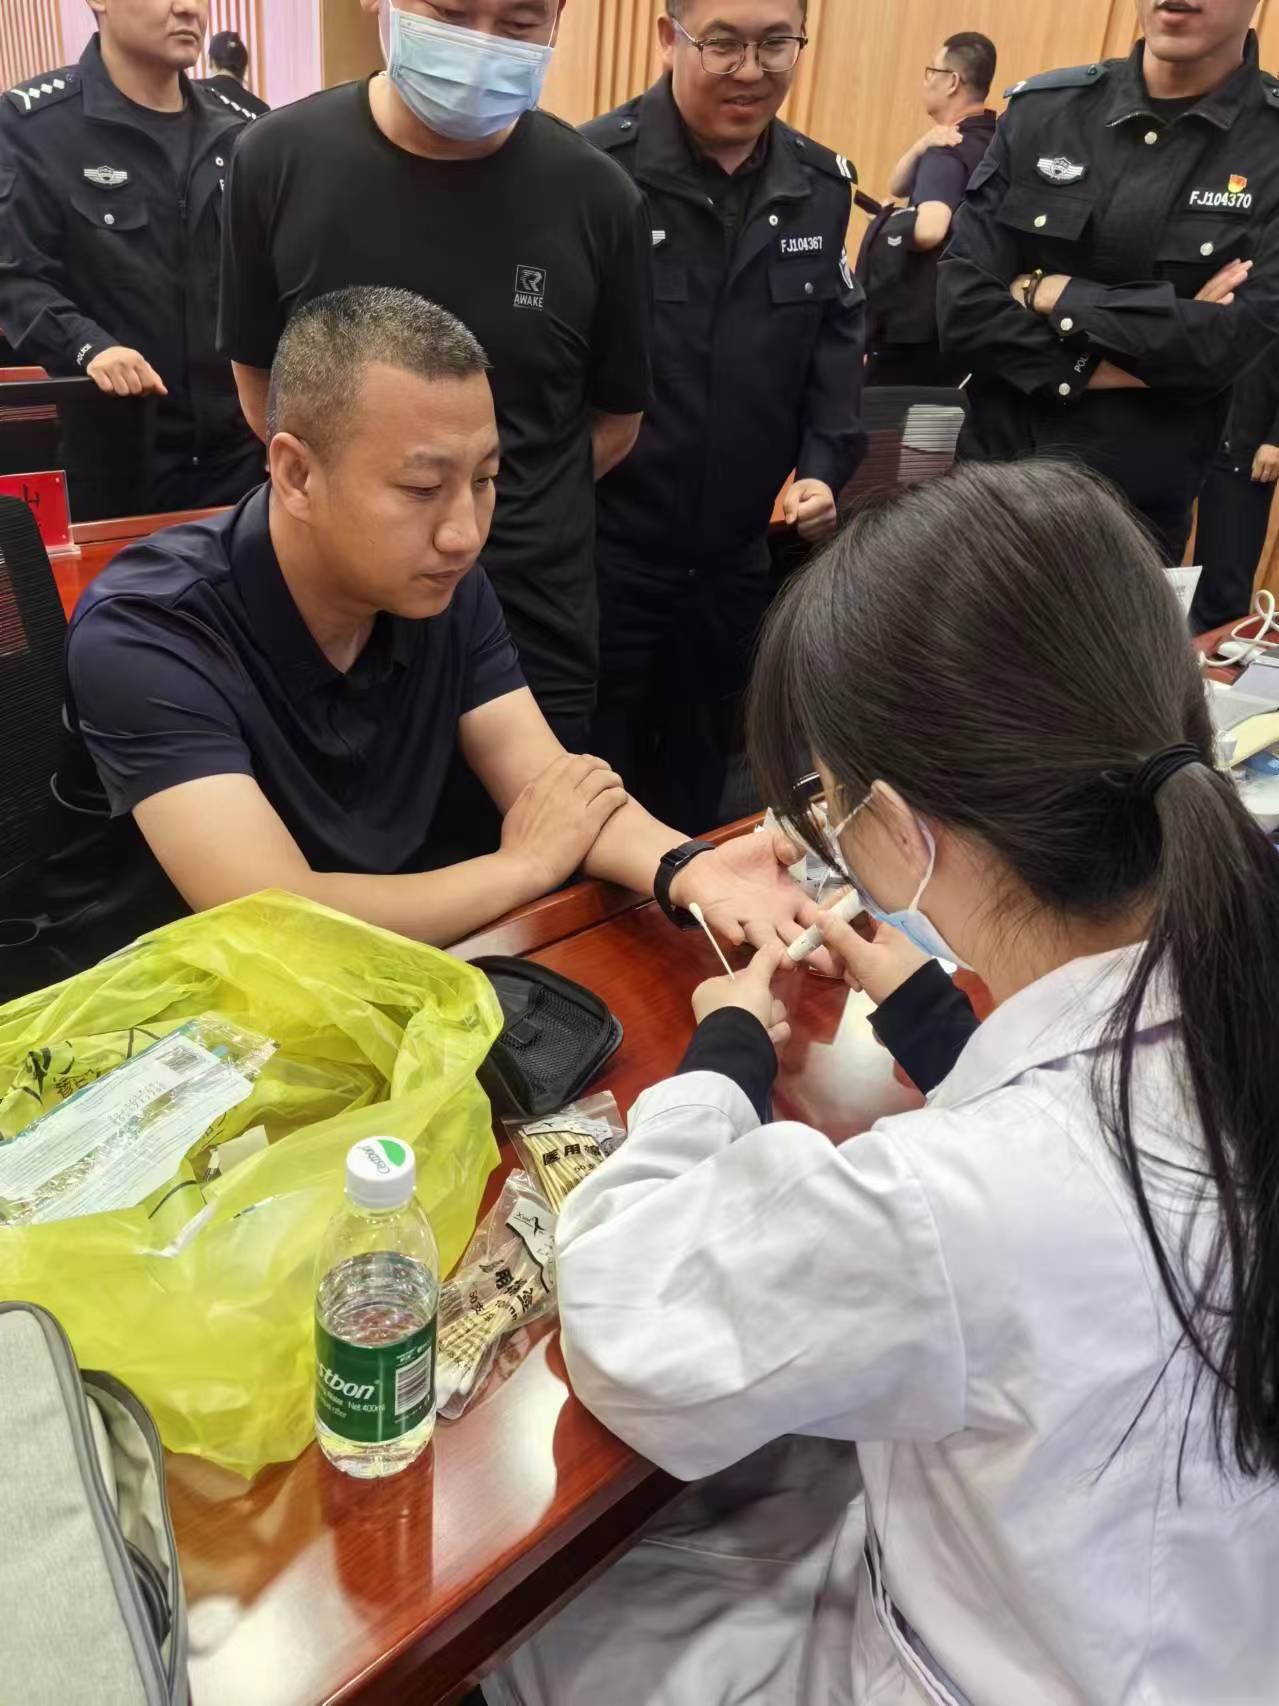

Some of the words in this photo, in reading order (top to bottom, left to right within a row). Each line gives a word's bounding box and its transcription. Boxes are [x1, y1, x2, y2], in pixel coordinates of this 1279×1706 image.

[1188, 189, 1253, 209] FJ104370
[780, 235, 824, 254] FJ104367
[513, 292, 545, 309] AWAKE
